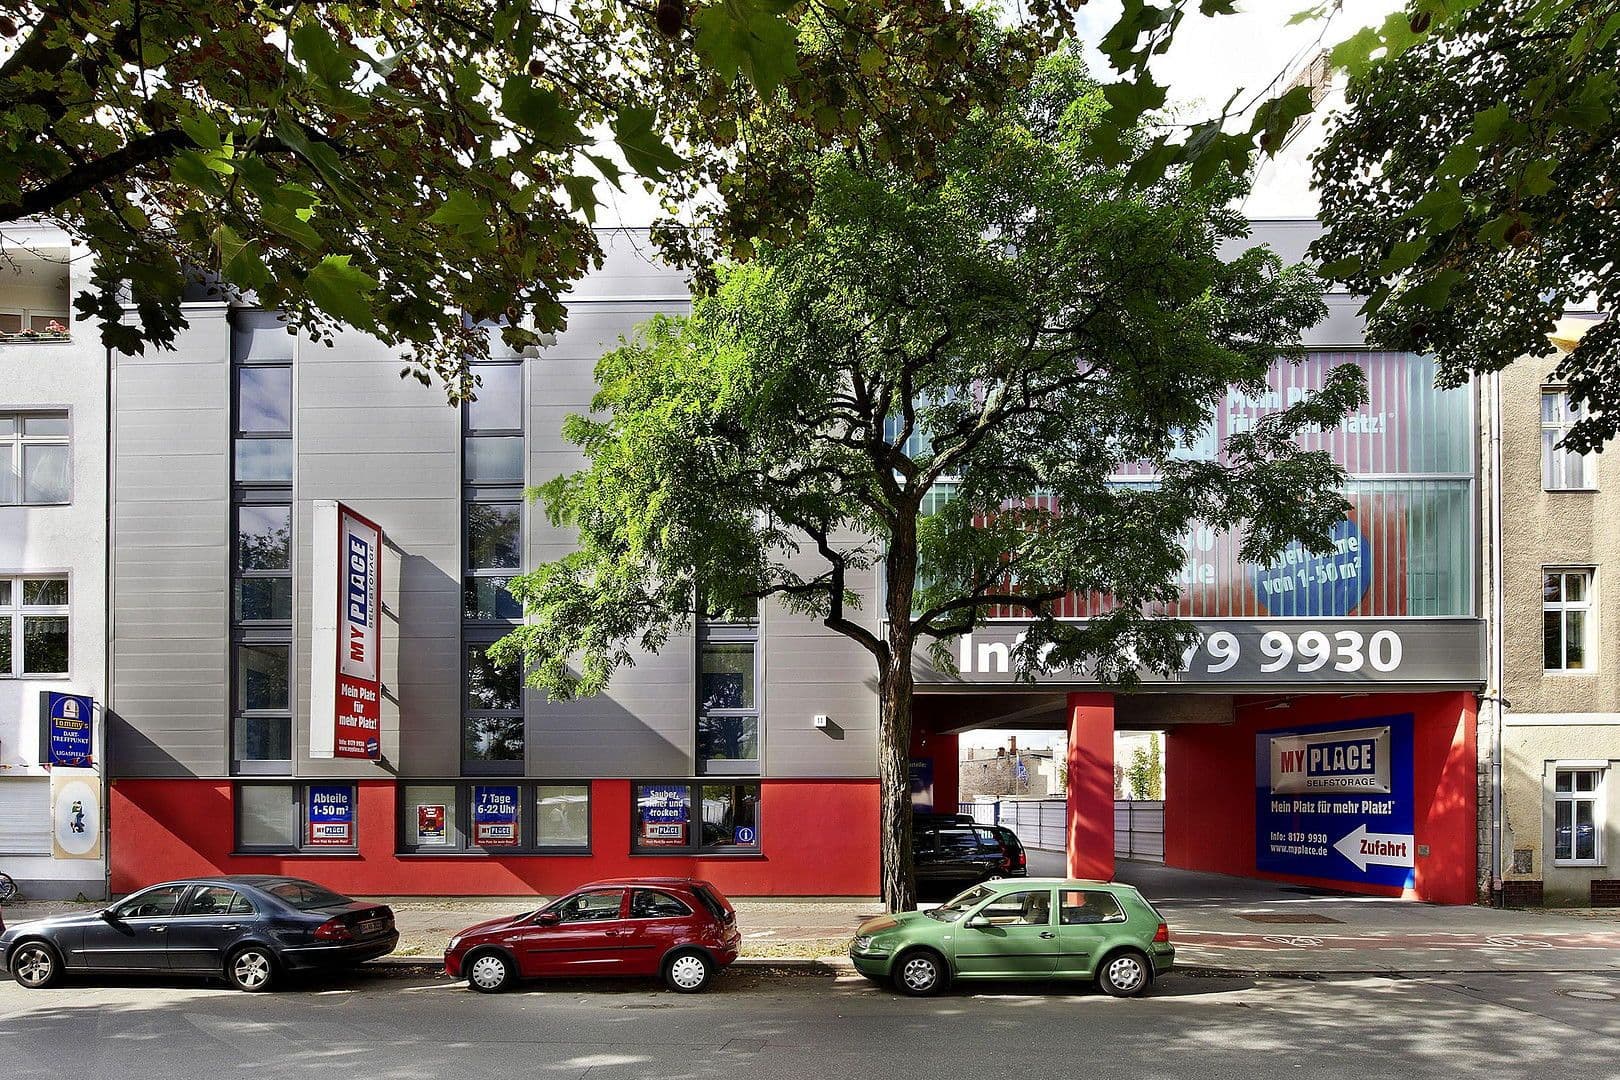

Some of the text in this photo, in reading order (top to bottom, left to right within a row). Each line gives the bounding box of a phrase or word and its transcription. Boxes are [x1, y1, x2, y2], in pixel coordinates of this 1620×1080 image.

[1336, 411, 1387, 433] latz!
[1262, 575, 1294, 595] von
[1297, 562, 1339, 588] 1-50
[350, 539, 366, 662] MY PLACE
[1260, 630, 1403, 673] 9930
[341, 683, 376, 701] Mein Platz
[353, 701, 364, 714] für
[339, 715, 377, 729] mehr Platz!
[53, 736, 89, 744] TREFFPUNKT
[1281, 744, 1371, 773] MY PLACE
[1306, 777, 1376, 787] SELFSTORAGE
[313, 793, 348, 804] Abteile
[481, 794, 511, 804] 7 Tage
[669, 799, 683, 808] und
[312, 805, 335, 816] 1-50
[477, 804, 515, 814] 6-22 Uhr
[648, 808, 679, 817] trocken
[1271, 800, 1392, 815] Mein Platz für mehr Platz!
[1270, 832, 1328, 844] Info: 8179 9930
[1270, 844, 1328, 856] www.myplace.de
[1359, 839, 1407, 858] Zufahrt
